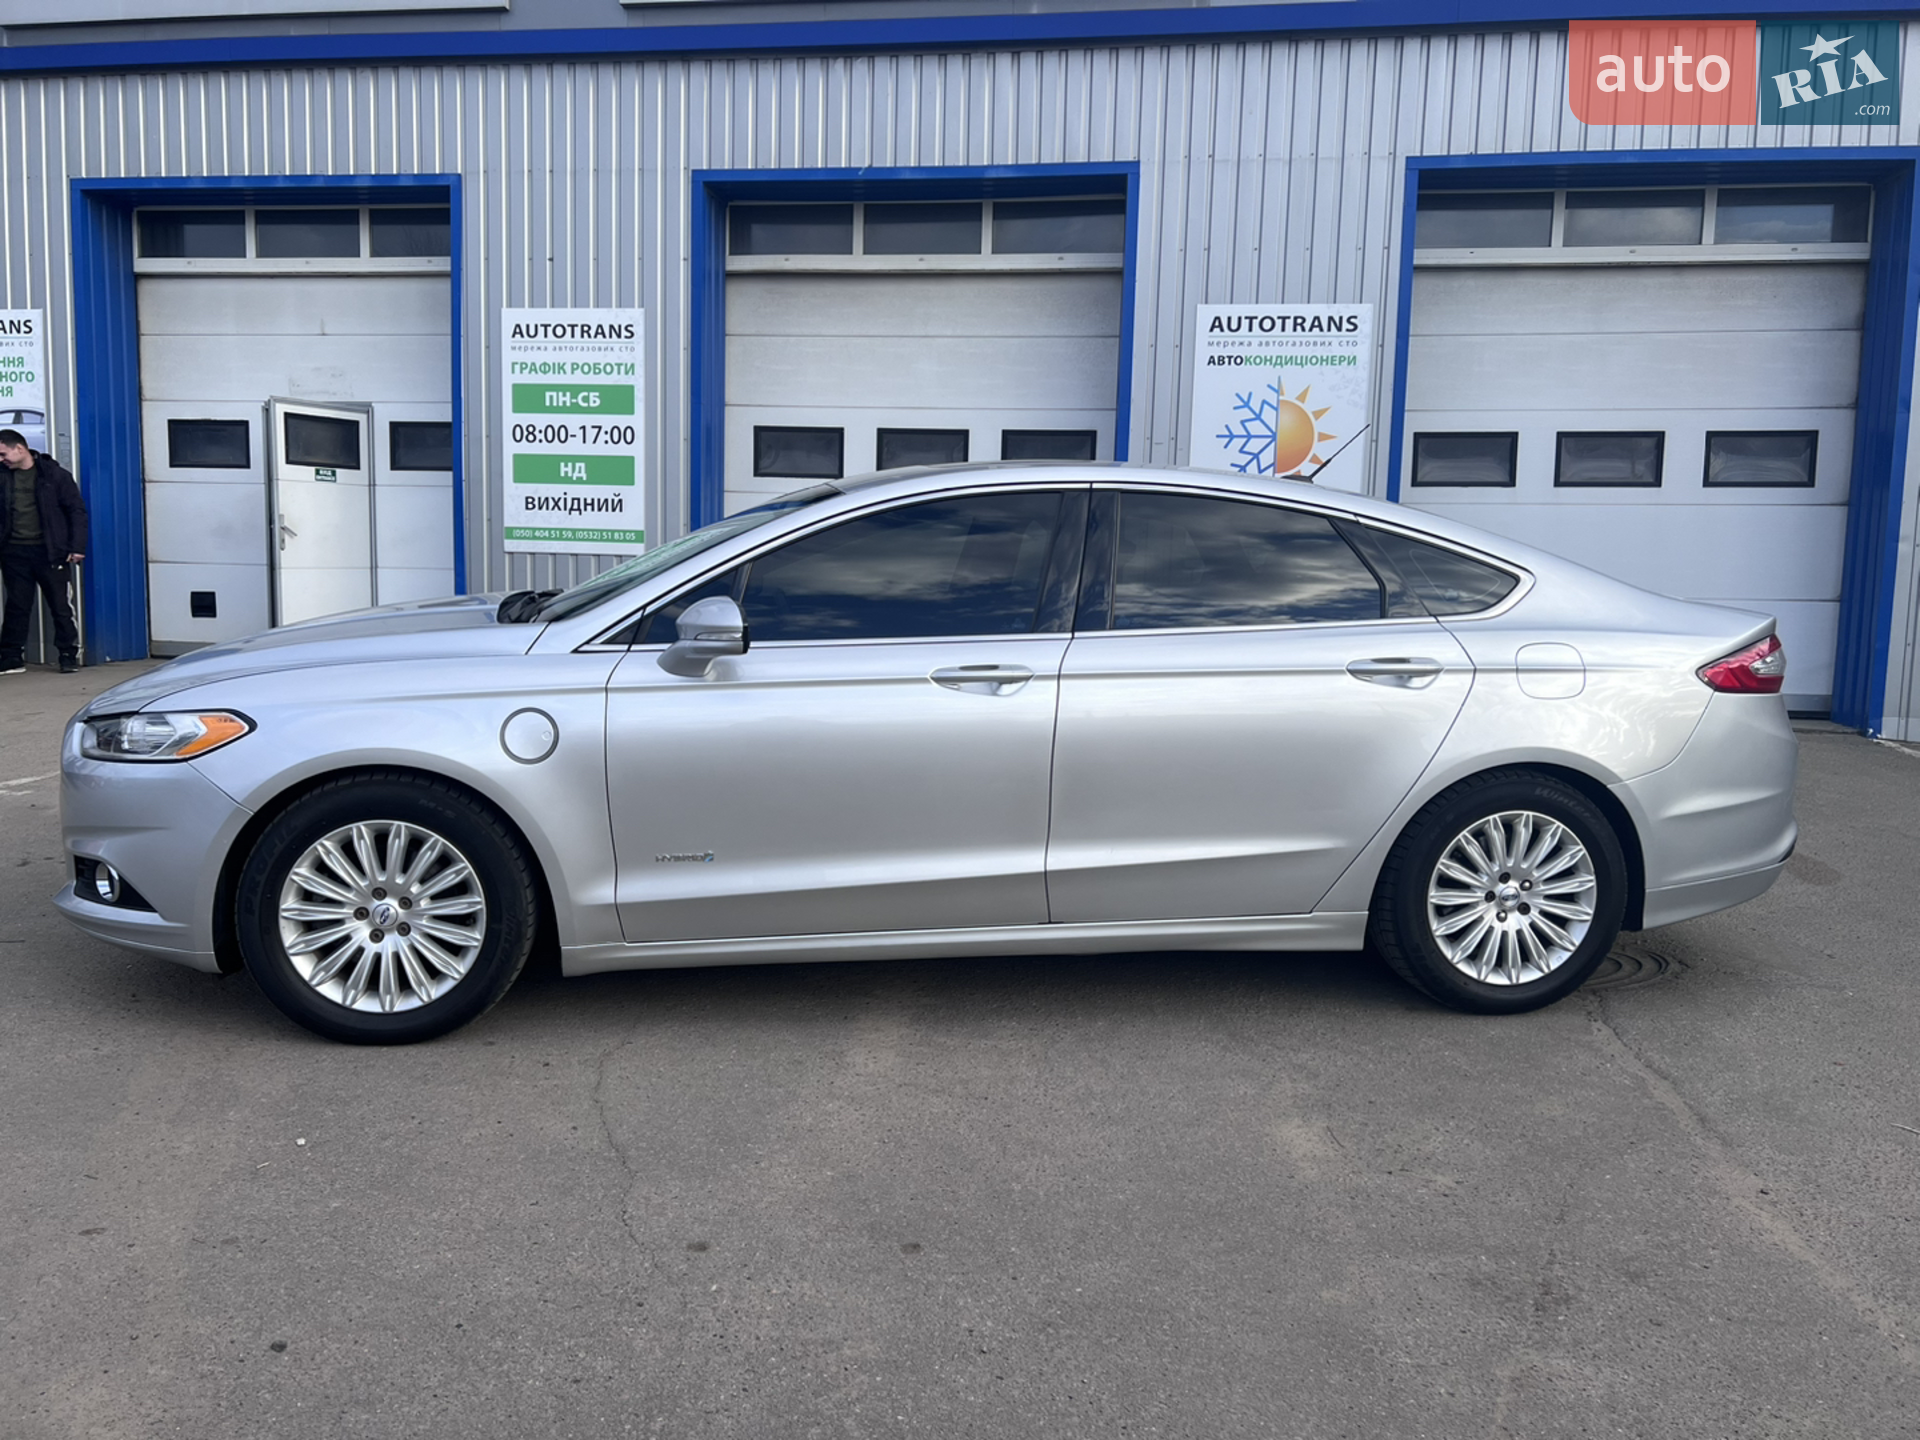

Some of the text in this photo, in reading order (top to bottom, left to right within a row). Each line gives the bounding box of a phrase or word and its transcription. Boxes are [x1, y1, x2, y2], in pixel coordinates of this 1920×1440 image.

[511, 323, 635, 339] AUTOTRANS
[1209, 315, 1358, 332] AUTOTRANS
[510, 345, 548, 353] мережа
[1207, 340, 1252, 349] мережа
[511, 361, 635, 376] ГРАФІК РОБОТИ
[1207, 355, 1357, 368] АВТОКОНДИЦІОНЕРИ
[544, 391, 601, 407] ПН-СБ
[512, 423, 635, 445] 08:00-17:00
[560, 462, 587, 480] НД
[524, 492, 623, 515] вихідний
[512, 529, 636, 540] (050) 404 51 59, (0532) 51 83 05
